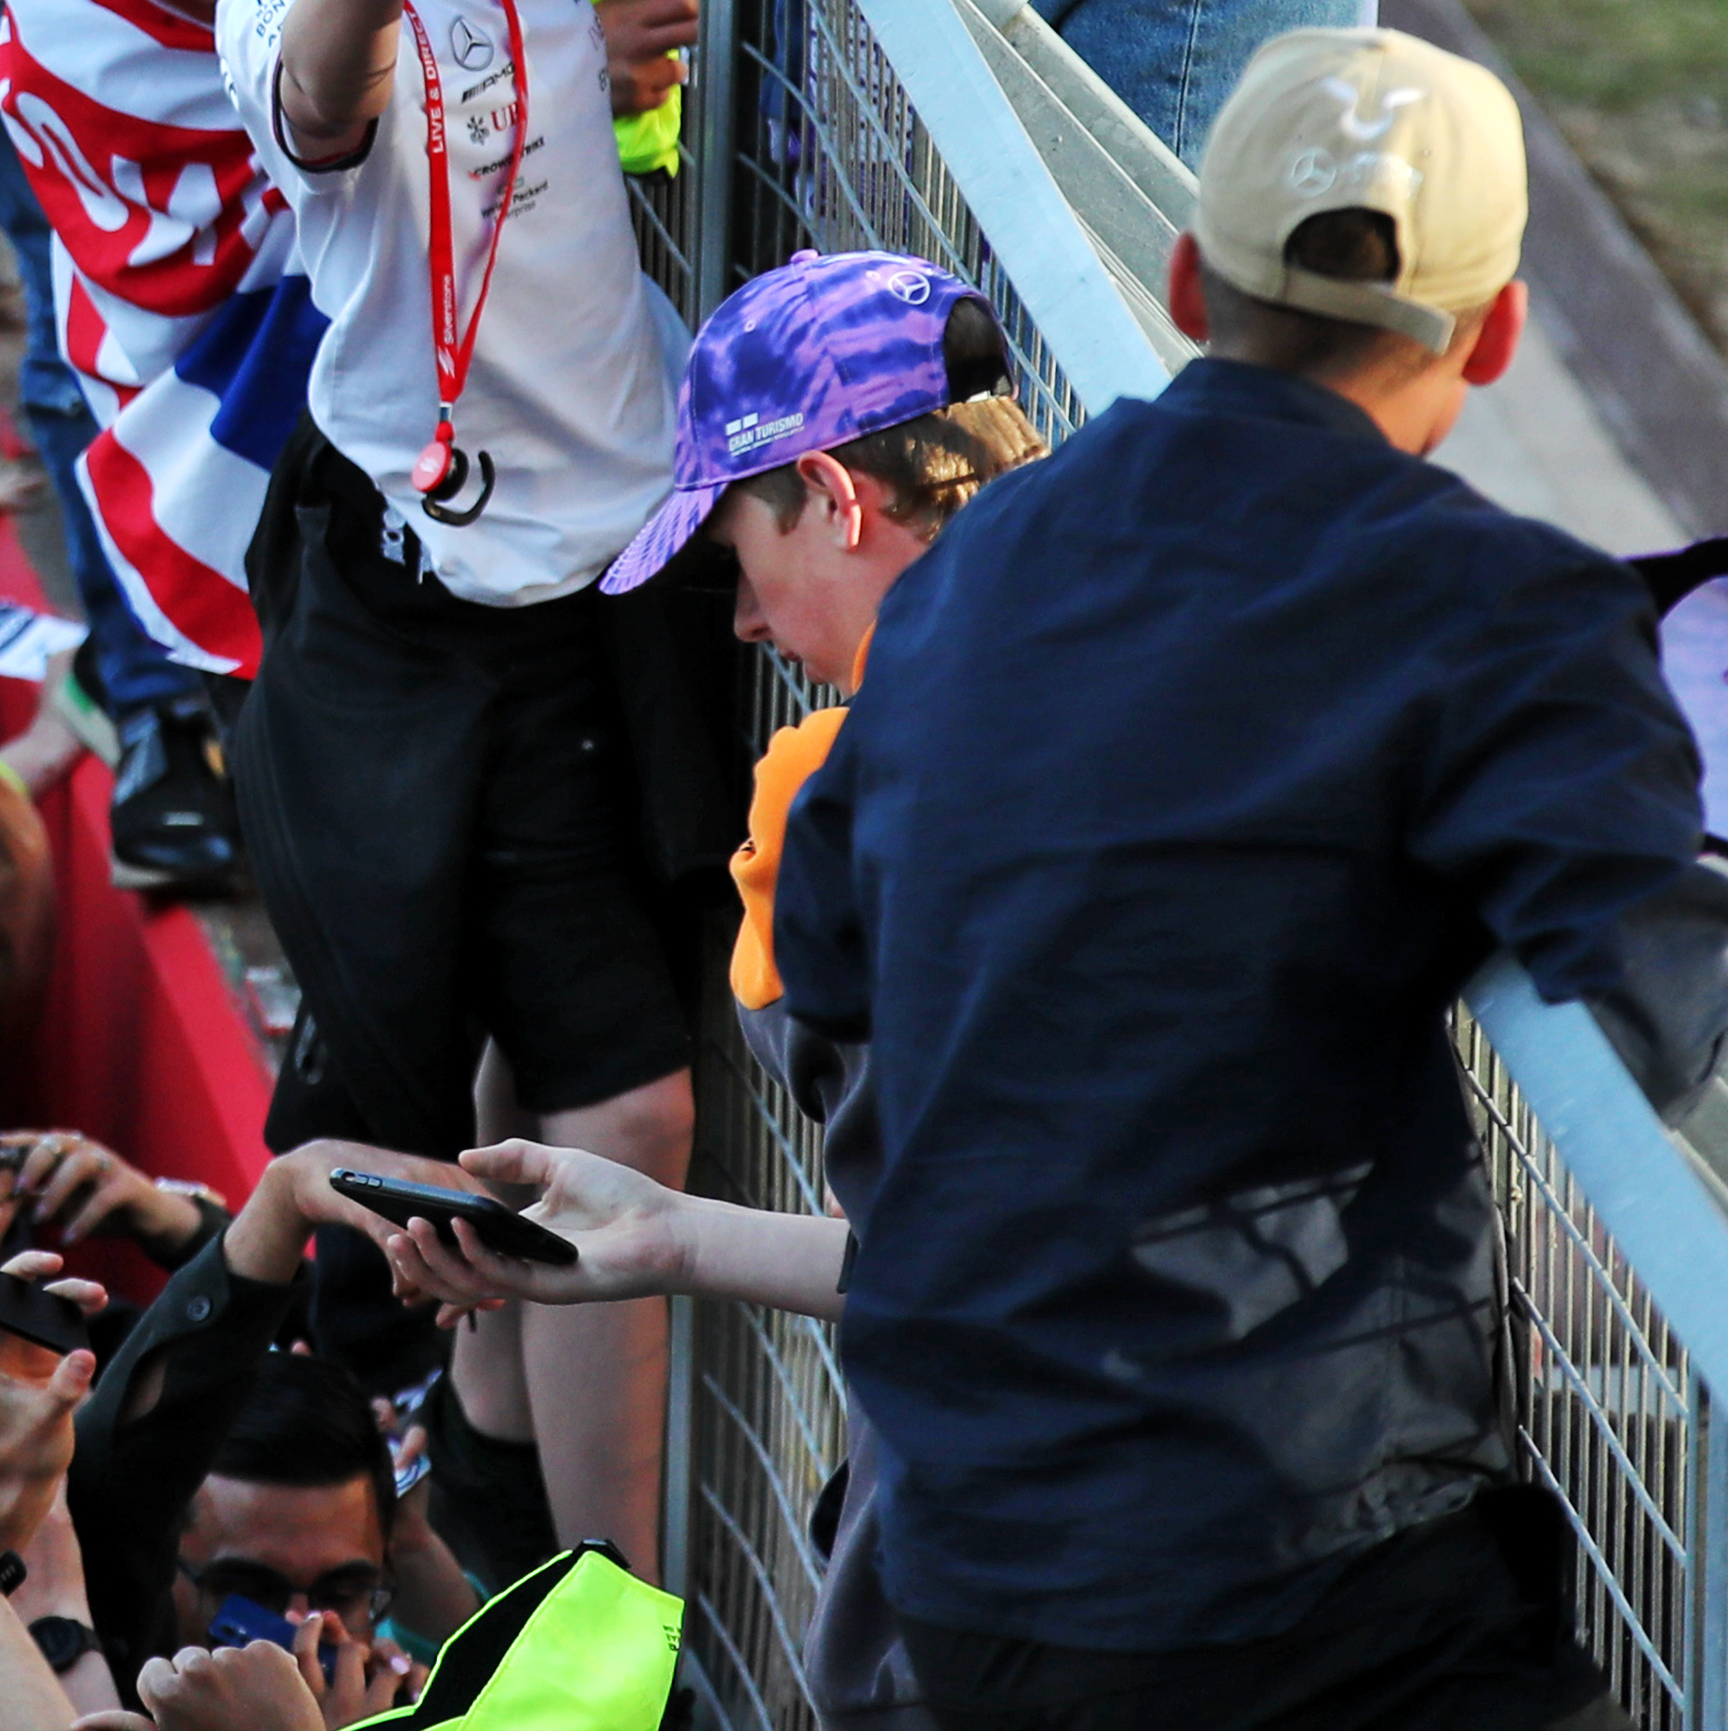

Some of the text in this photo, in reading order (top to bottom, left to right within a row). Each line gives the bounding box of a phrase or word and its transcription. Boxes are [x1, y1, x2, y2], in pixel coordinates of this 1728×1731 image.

[410, 10, 444, 154] LIVE & DIRECT
[443, 273, 455, 345] Silverstone
[729, 429, 755, 452] GRAN
[755, 412, 804, 441] TURISMO
